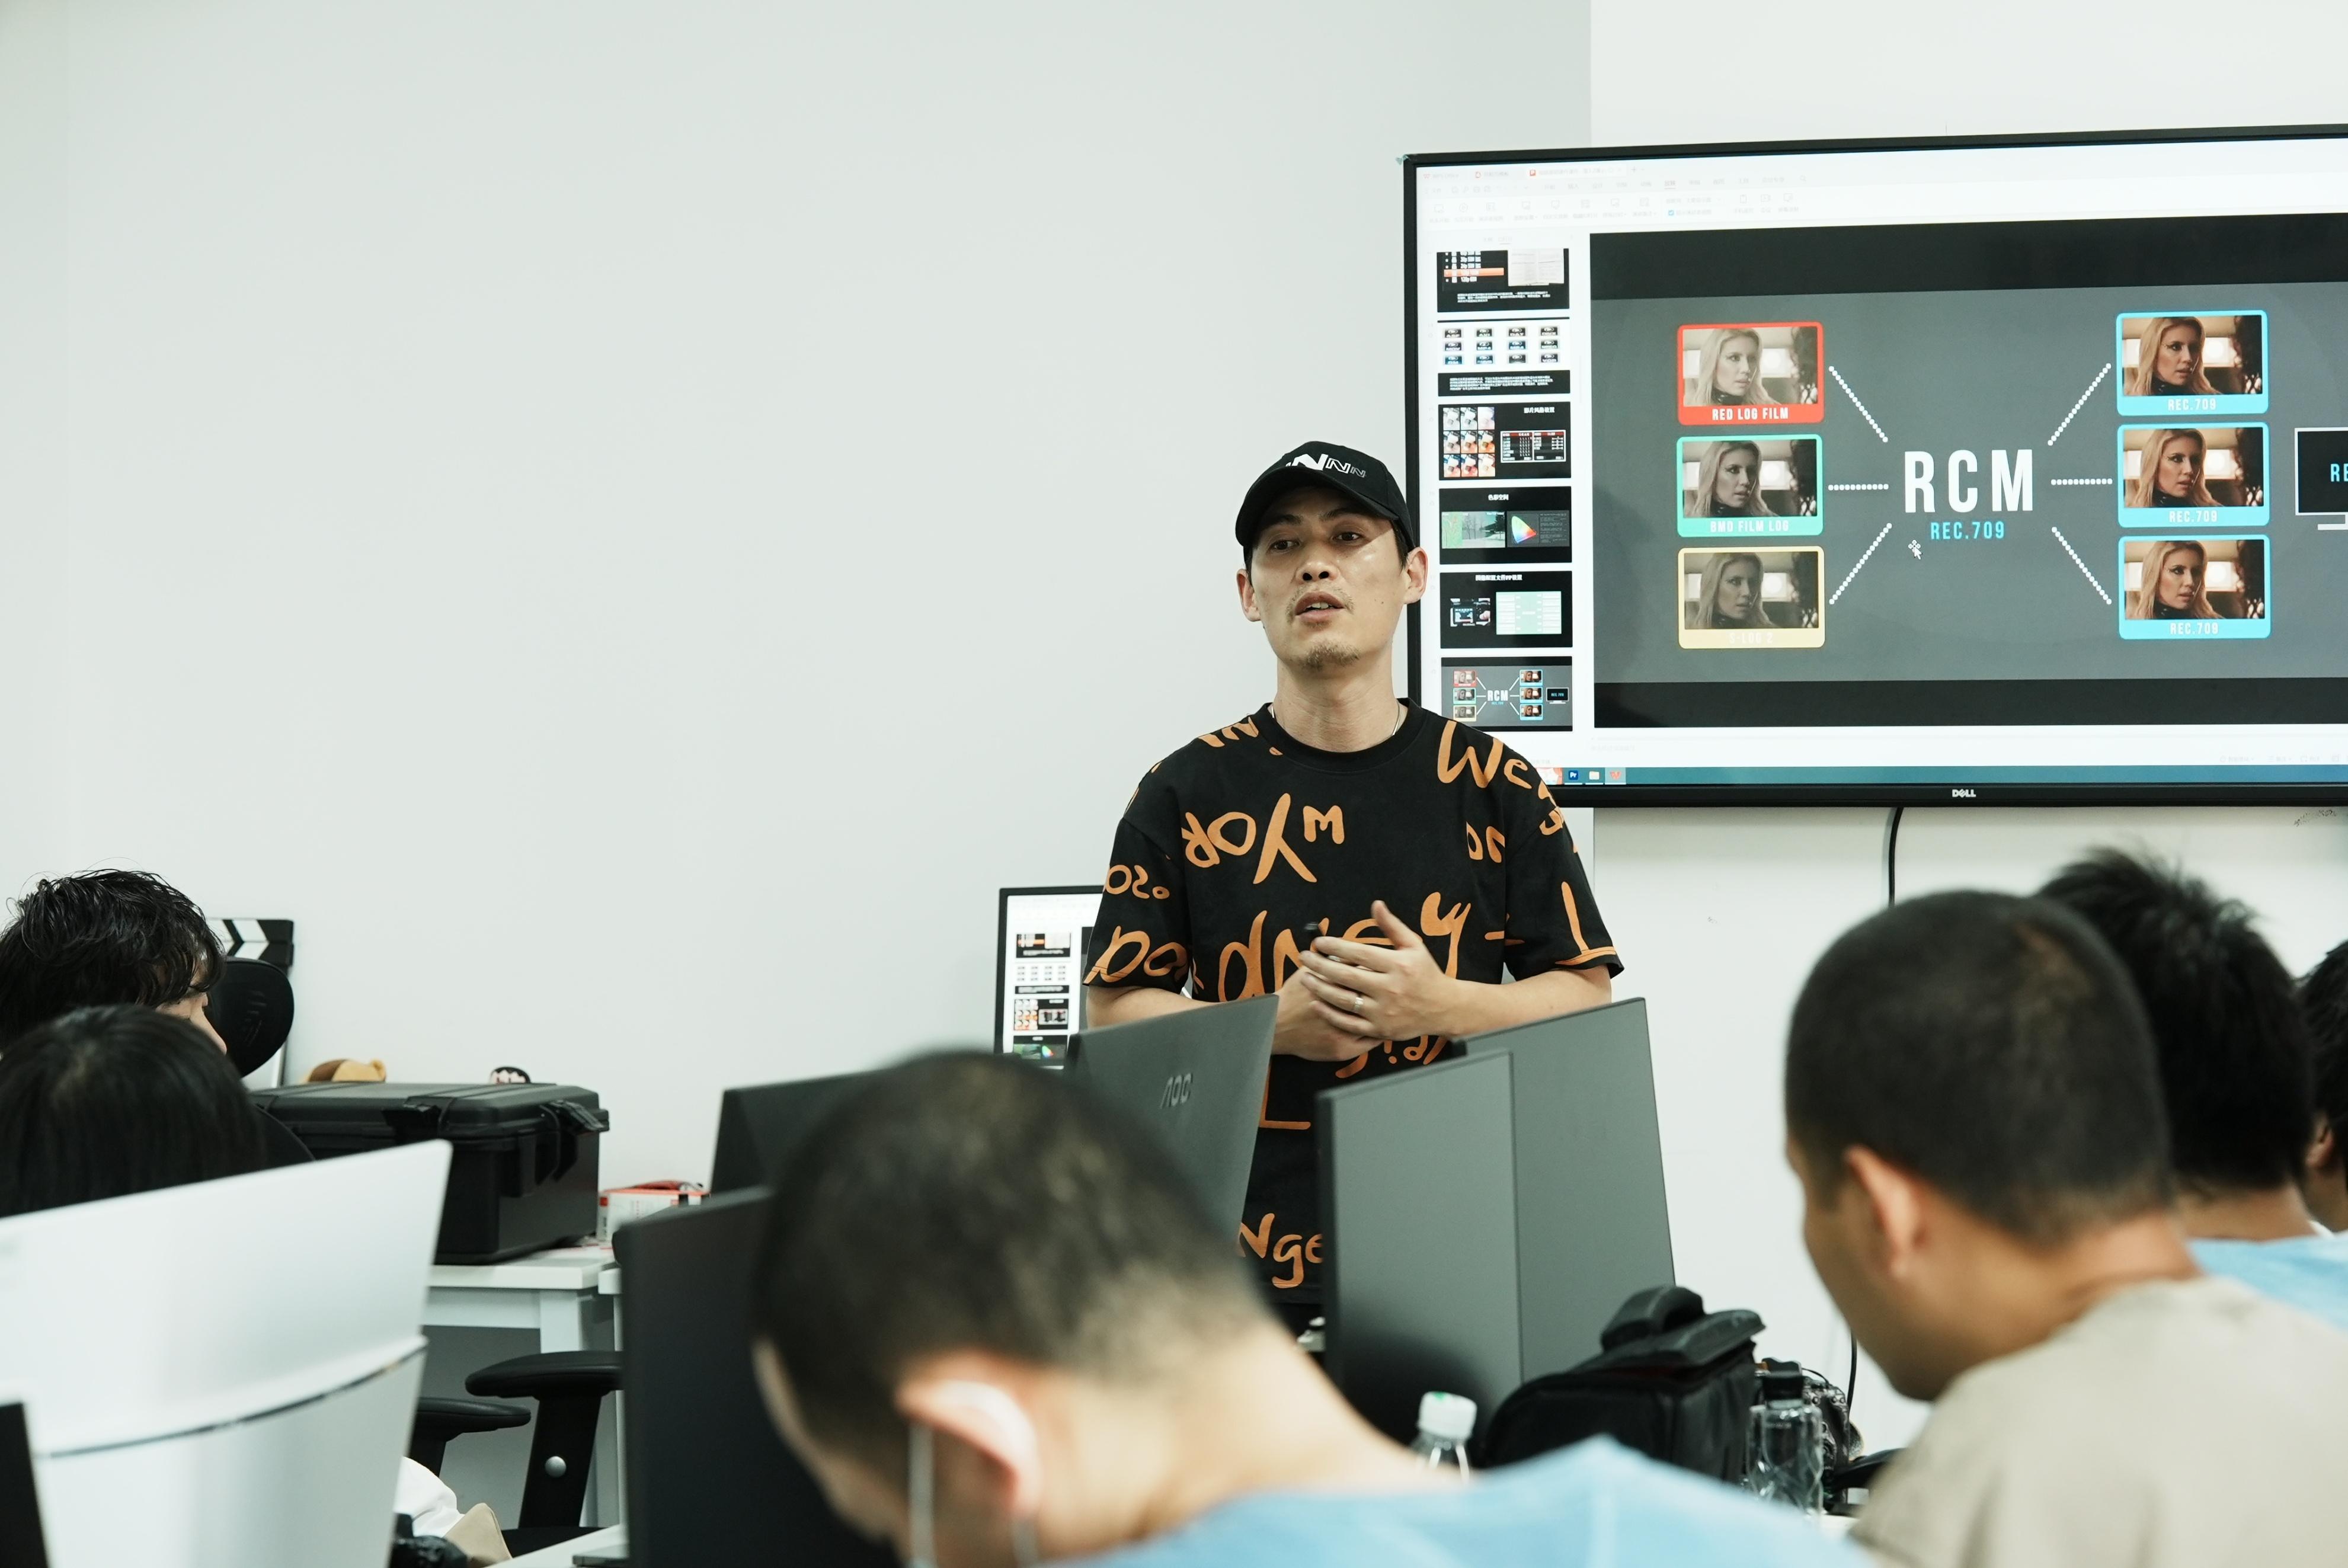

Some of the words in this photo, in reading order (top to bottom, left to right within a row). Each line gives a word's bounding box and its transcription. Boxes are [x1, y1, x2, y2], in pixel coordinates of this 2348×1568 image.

[2167, 398, 2216, 411] REC.709
[1712, 408, 1733, 421] RED
[1738, 408, 1758, 421] LOG
[1762, 407, 1789, 420] FILM
[1904, 449, 2033, 513] RCM
[2169, 510, 2218, 523] REC.709
[1710, 520, 1733, 533] BMD
[1738, 520, 1764, 532] FILM
[1768, 519, 1789, 532] LOG
[1930, 521, 2005, 540] REC.709
[2170, 622, 2219, 635] REC.709
[1729, 632, 1762, 645] S-LOG
[1766, 632, 1774, 645] 2
[1488, 690, 1508, 702] RCM
[1952, 789, 1977, 798] DELL
